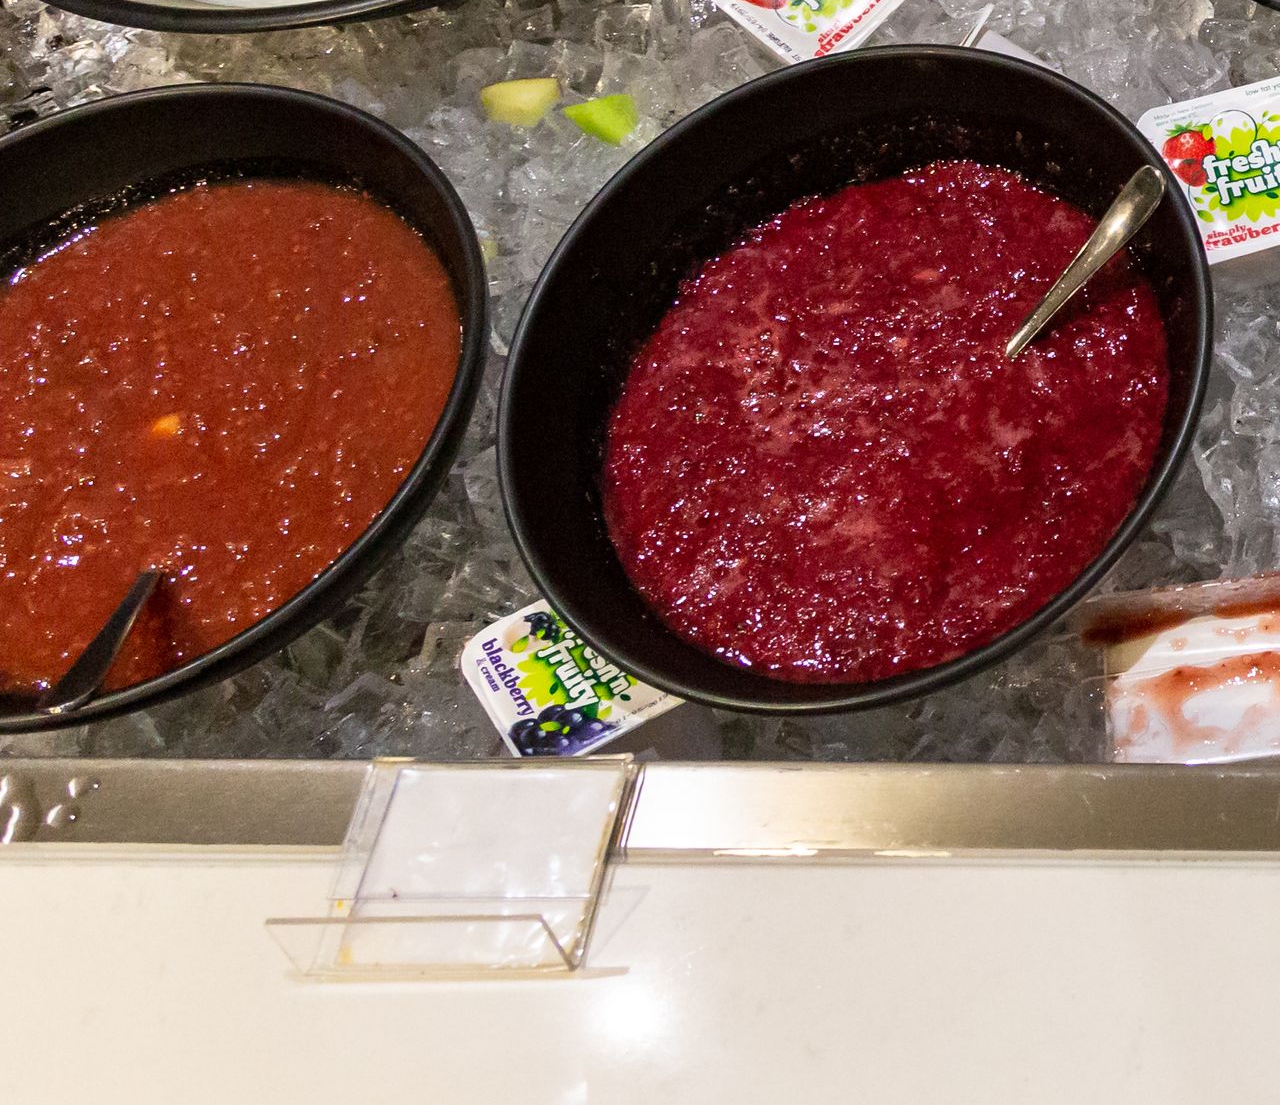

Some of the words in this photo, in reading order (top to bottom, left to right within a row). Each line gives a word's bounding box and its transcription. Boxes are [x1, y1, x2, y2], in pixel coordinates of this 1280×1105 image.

[1244, 87, 1258, 96] low
[1260, 84, 1271, 92] fat
[480, 665, 501, 693] cream
[481, 638, 535, 716] blackberry
[535, 639, 600, 710] fruity
